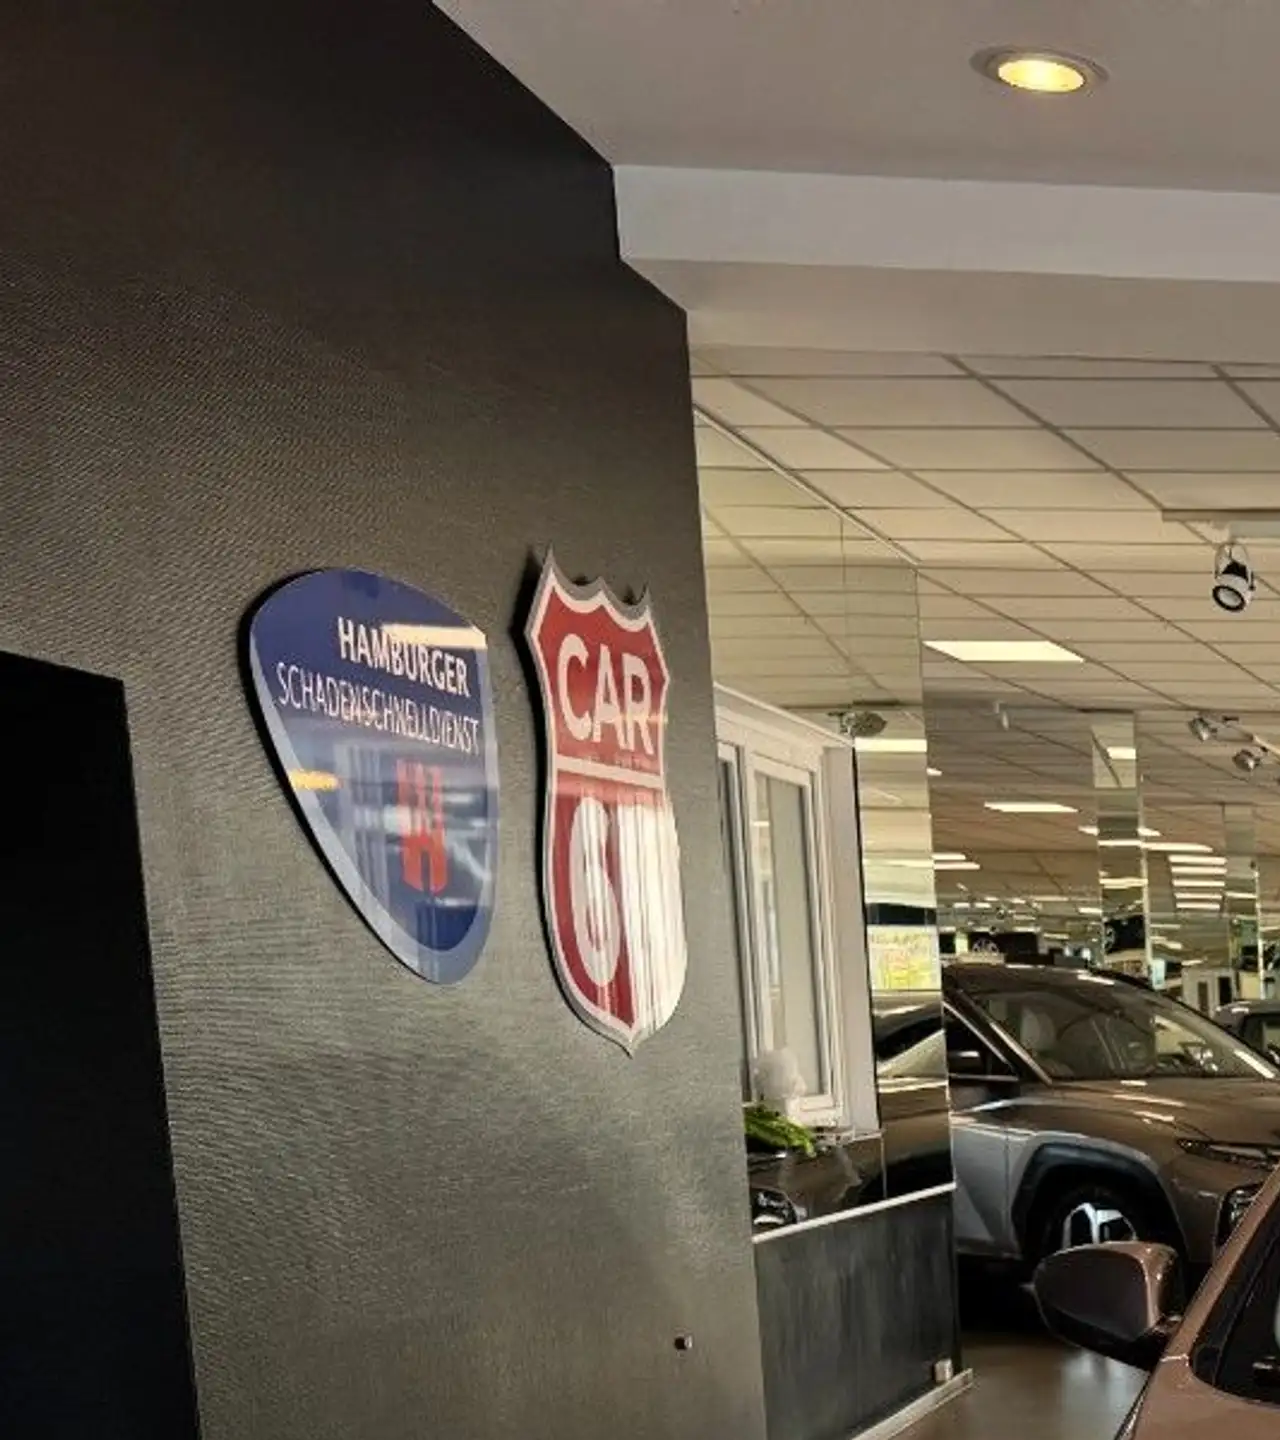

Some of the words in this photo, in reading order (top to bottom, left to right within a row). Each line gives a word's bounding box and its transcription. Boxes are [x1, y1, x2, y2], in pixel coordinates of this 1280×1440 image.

[337, 615, 471, 699] HAMBURGER
[557, 632, 655, 756] CAR
[275, 661, 480, 754] SCHADENSCHNELLDIENST
